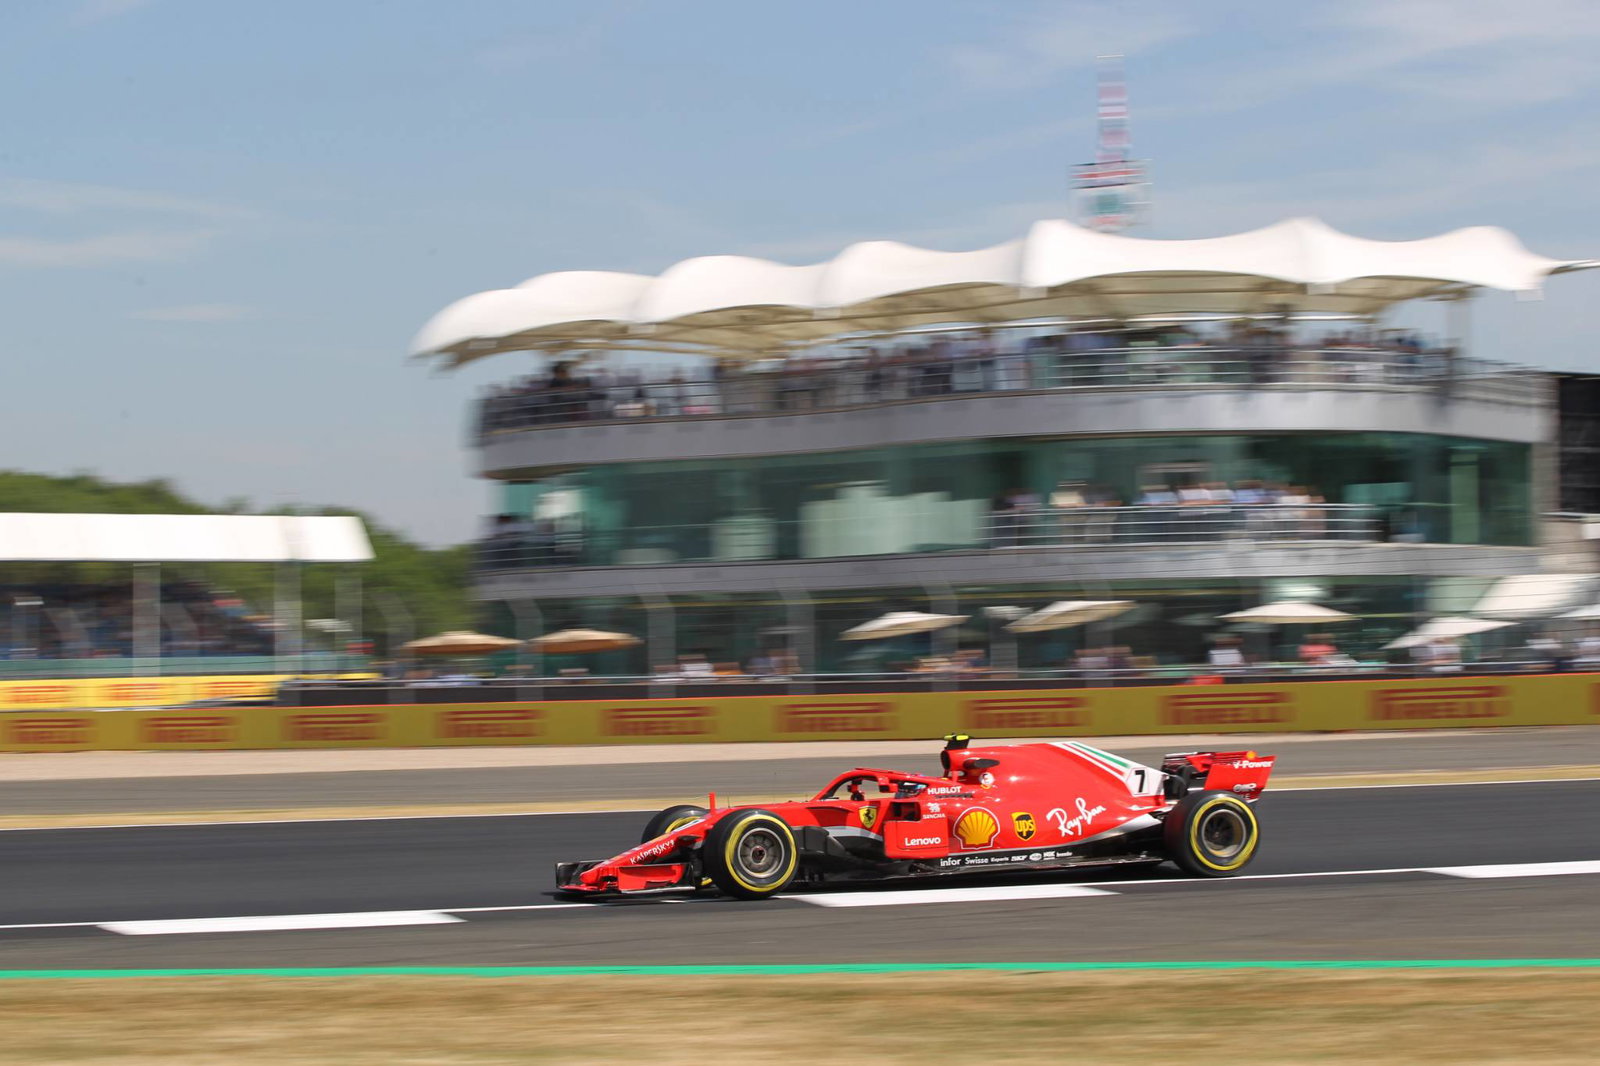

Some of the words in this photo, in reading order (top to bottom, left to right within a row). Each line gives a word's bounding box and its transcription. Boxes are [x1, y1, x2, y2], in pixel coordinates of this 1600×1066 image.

[1135, 769, 1146, 793] 7
[927, 786, 962, 795] HUBLOT
[1046, 797, 1107, 837] Ray-Ban
[904, 837, 942, 847] Lenovo
[940, 856, 961, 867] infor
[964, 856, 989, 865] Swisse
